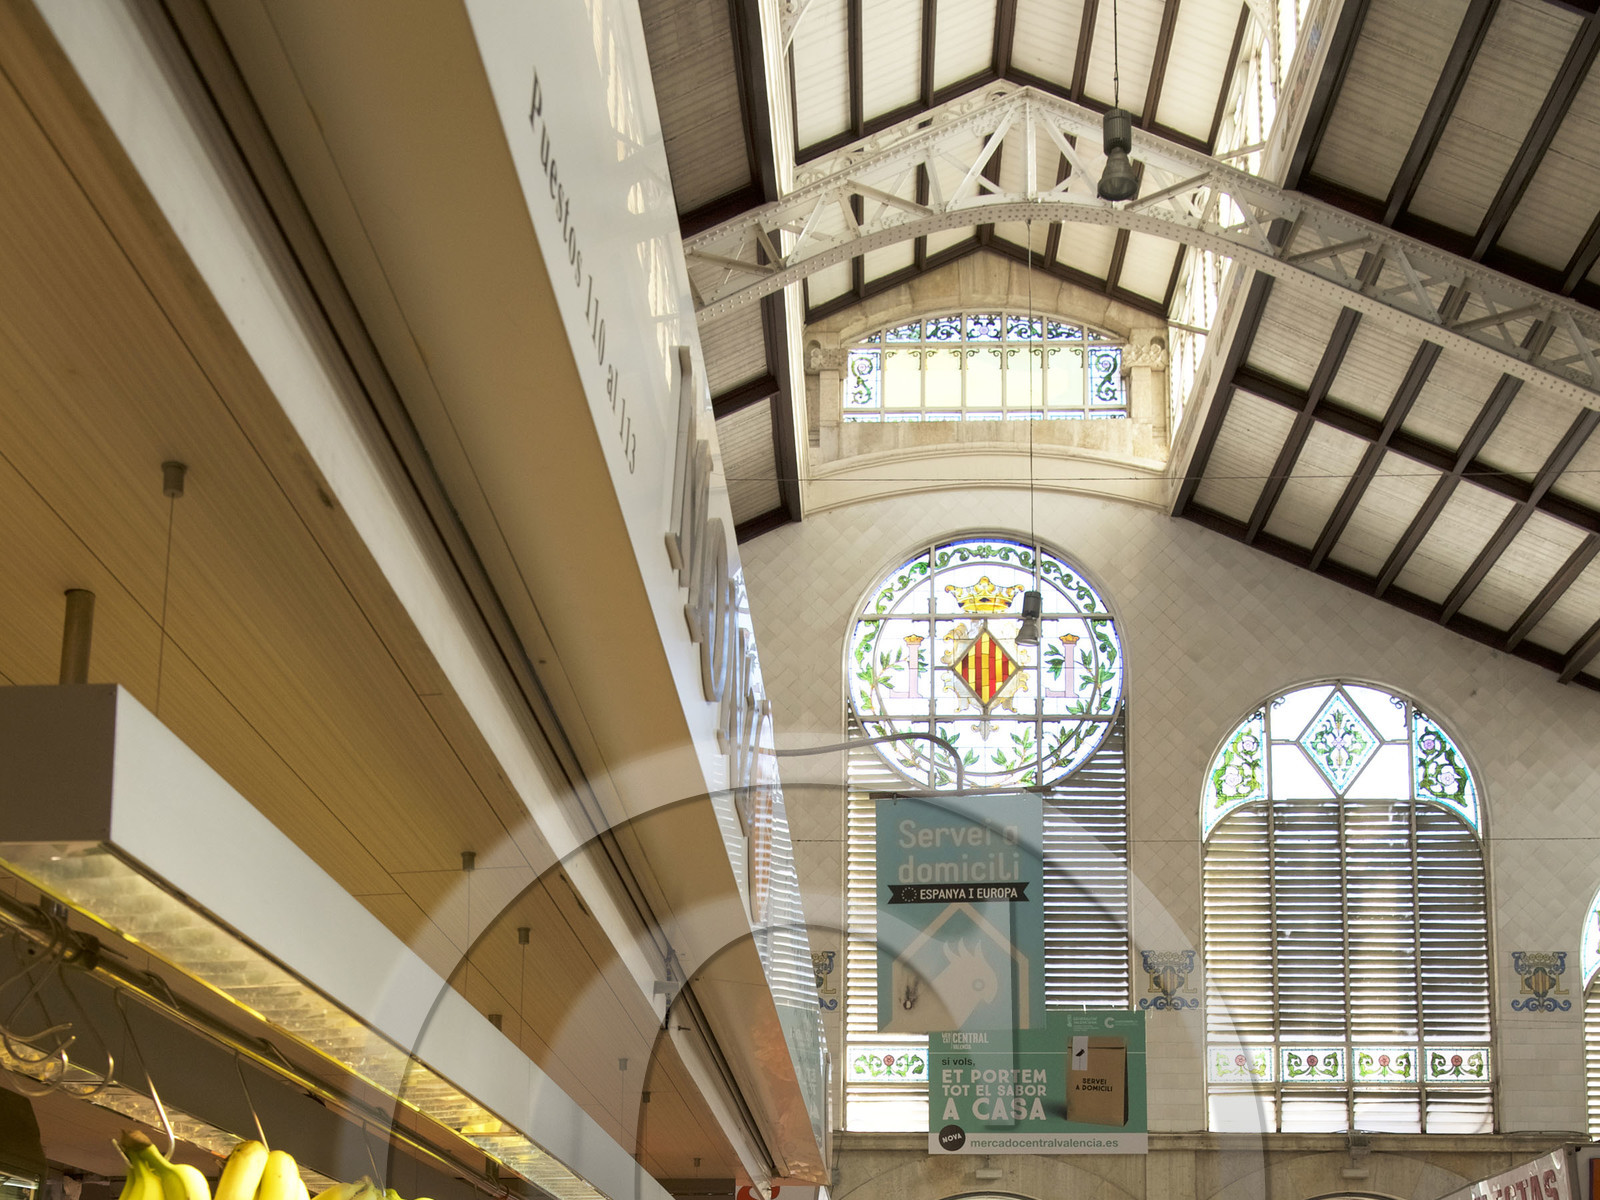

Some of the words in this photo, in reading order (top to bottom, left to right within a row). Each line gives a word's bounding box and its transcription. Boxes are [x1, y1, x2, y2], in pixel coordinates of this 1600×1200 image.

[528, 65, 584, 288] Puestos
[585, 274, 606, 366] 110
[606, 363, 619, 414] al
[898, 818, 992, 849] Servei
[898, 852, 1020, 884] domicili
[919, 888, 967, 900] ESPANYA
[968, 887, 975, 899] I
[976, 887, 1018, 899] EUROPA
[952, 1032, 989, 1044] CENTRAL
[952, 1057, 976, 1067] vols,
[942, 1069, 961, 1083] ET
[971, 1069, 1047, 1083] PORTEM
[942, 1084, 970, 1096] TOT
[976, 1084, 991, 1096] EL
[997, 1084, 1047, 1096] SABOR
[942, 1098, 960, 1120] A
[971, 1098, 1047, 1120] CASA
[942, 1132, 962, 1144] NOVA
[970, 1137, 1119, 1149] mercadocentralvalencia.es
